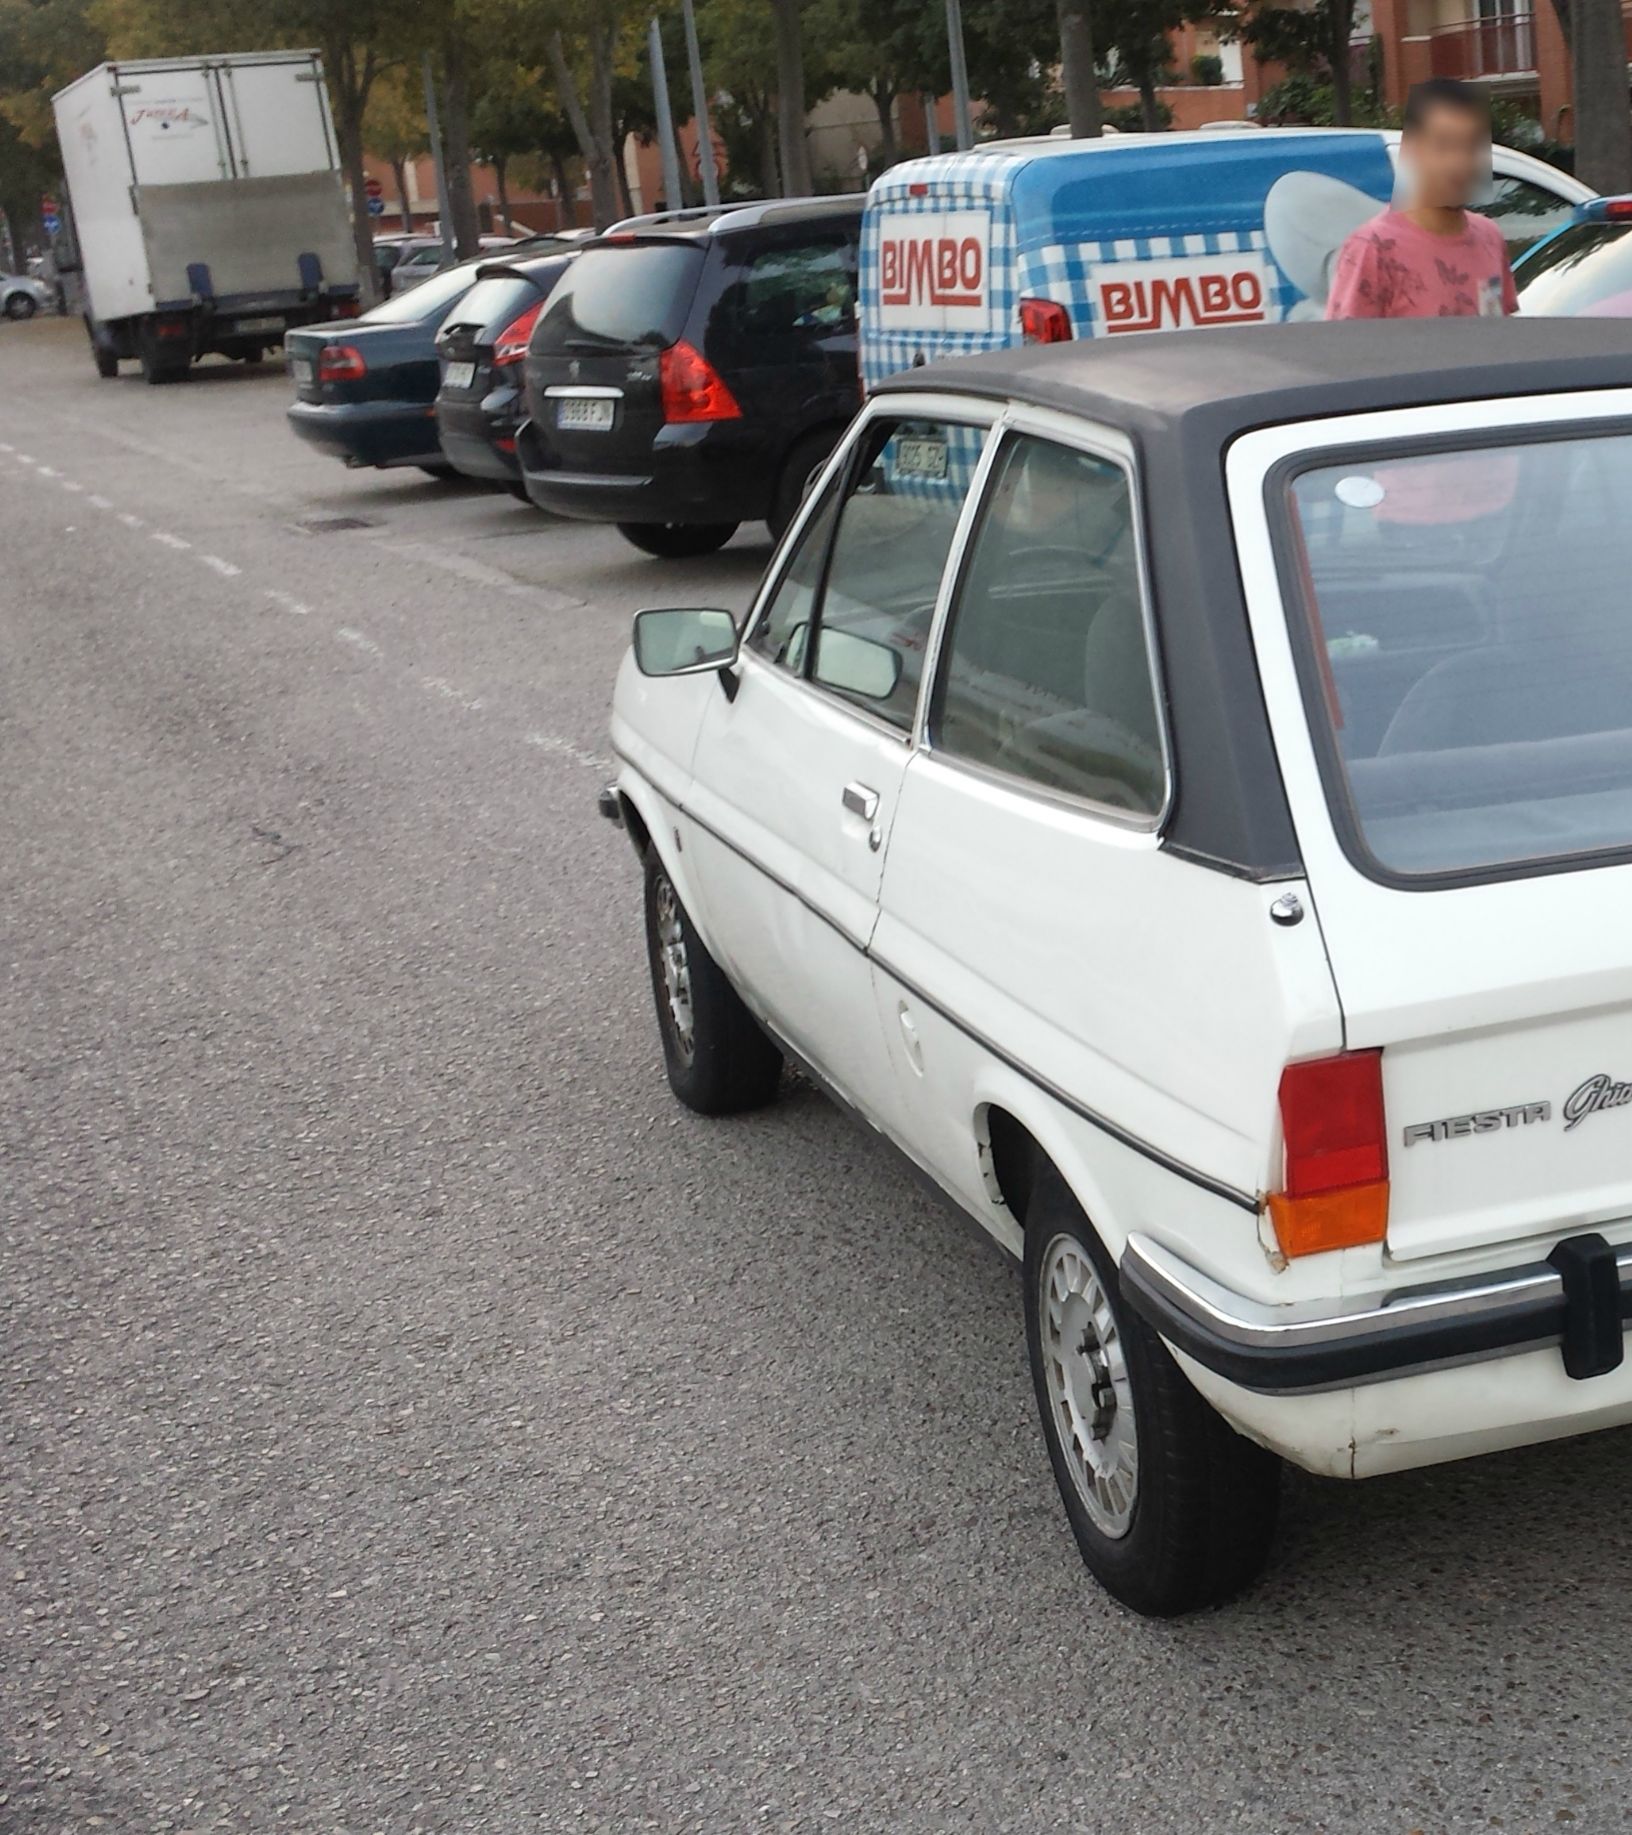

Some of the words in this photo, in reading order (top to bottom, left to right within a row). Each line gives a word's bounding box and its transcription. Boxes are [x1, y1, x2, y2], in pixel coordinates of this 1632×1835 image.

[882, 238, 982, 306] BIMBO
[1100, 271, 1265, 334] BIMBO
[1403, 1100, 1551, 1148] FIESTA
